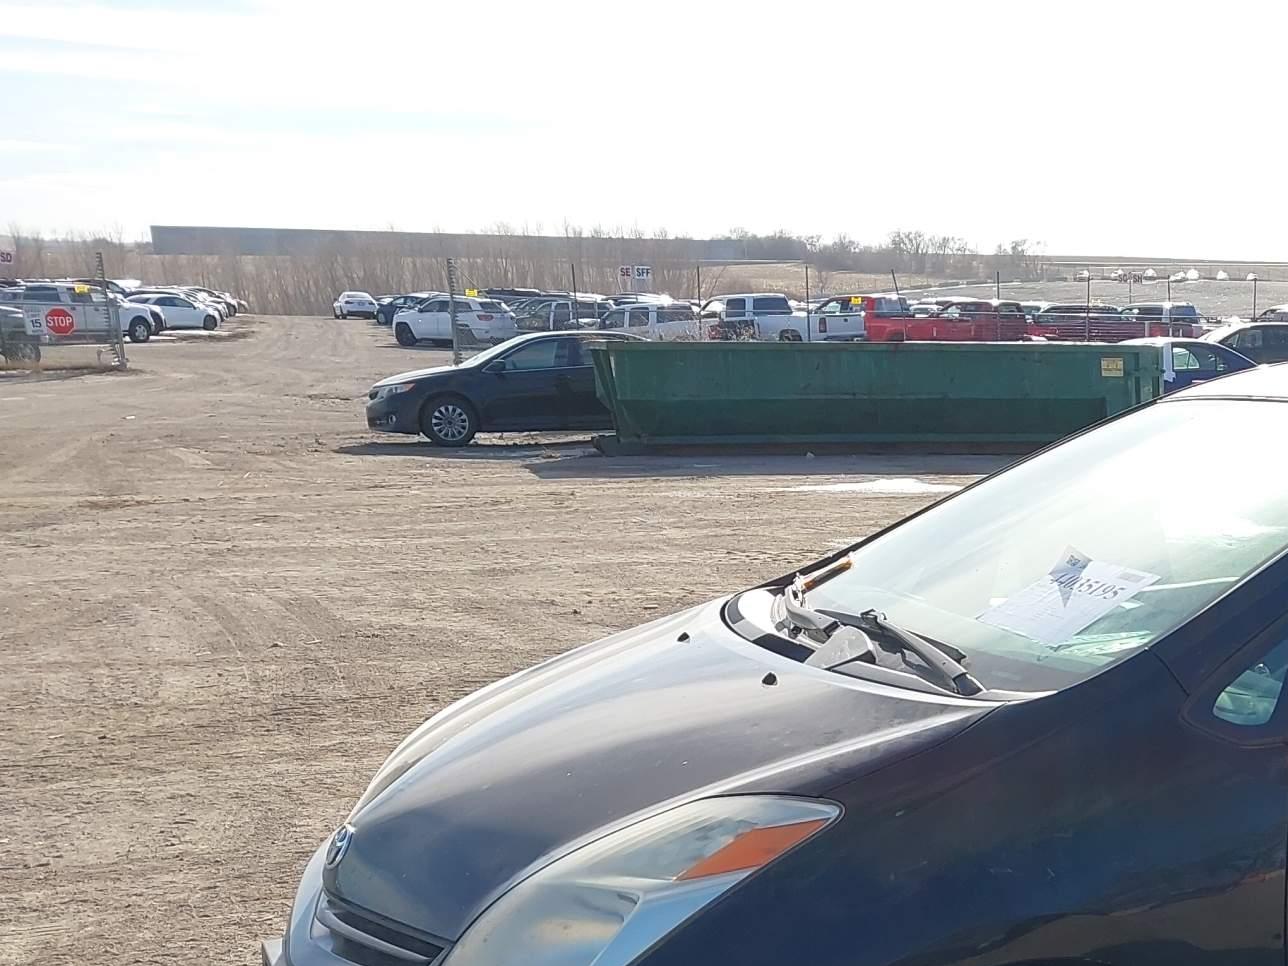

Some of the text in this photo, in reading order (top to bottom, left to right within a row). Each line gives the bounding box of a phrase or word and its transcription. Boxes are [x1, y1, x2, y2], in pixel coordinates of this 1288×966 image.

[620, 267, 631, 277] SE
[636, 267, 651, 278] SFF
[31, 318, 42, 328] 15
[47, 316, 73, 327] STOP
